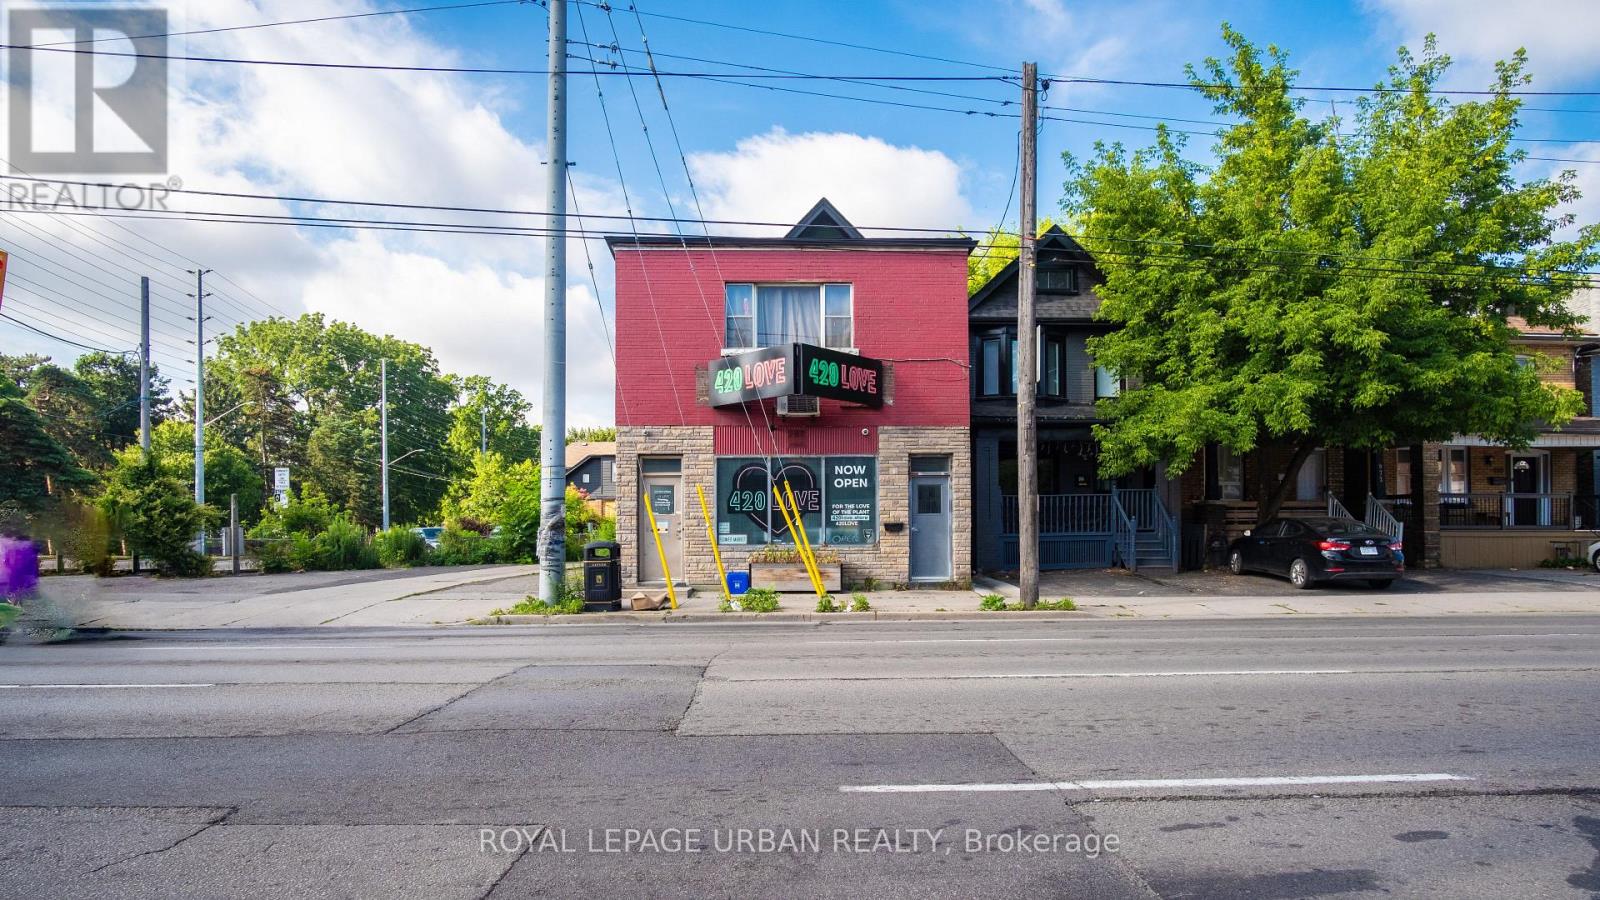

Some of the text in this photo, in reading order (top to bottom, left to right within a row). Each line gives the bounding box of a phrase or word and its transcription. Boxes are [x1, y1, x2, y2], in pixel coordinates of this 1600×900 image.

[715, 357, 786, 394] 420 LOVE
[809, 358, 877, 394] 420 LOVE
[834, 465, 866, 475] NOW
[833, 478, 868, 488] OPEN
[729, 490, 766, 511] 420
